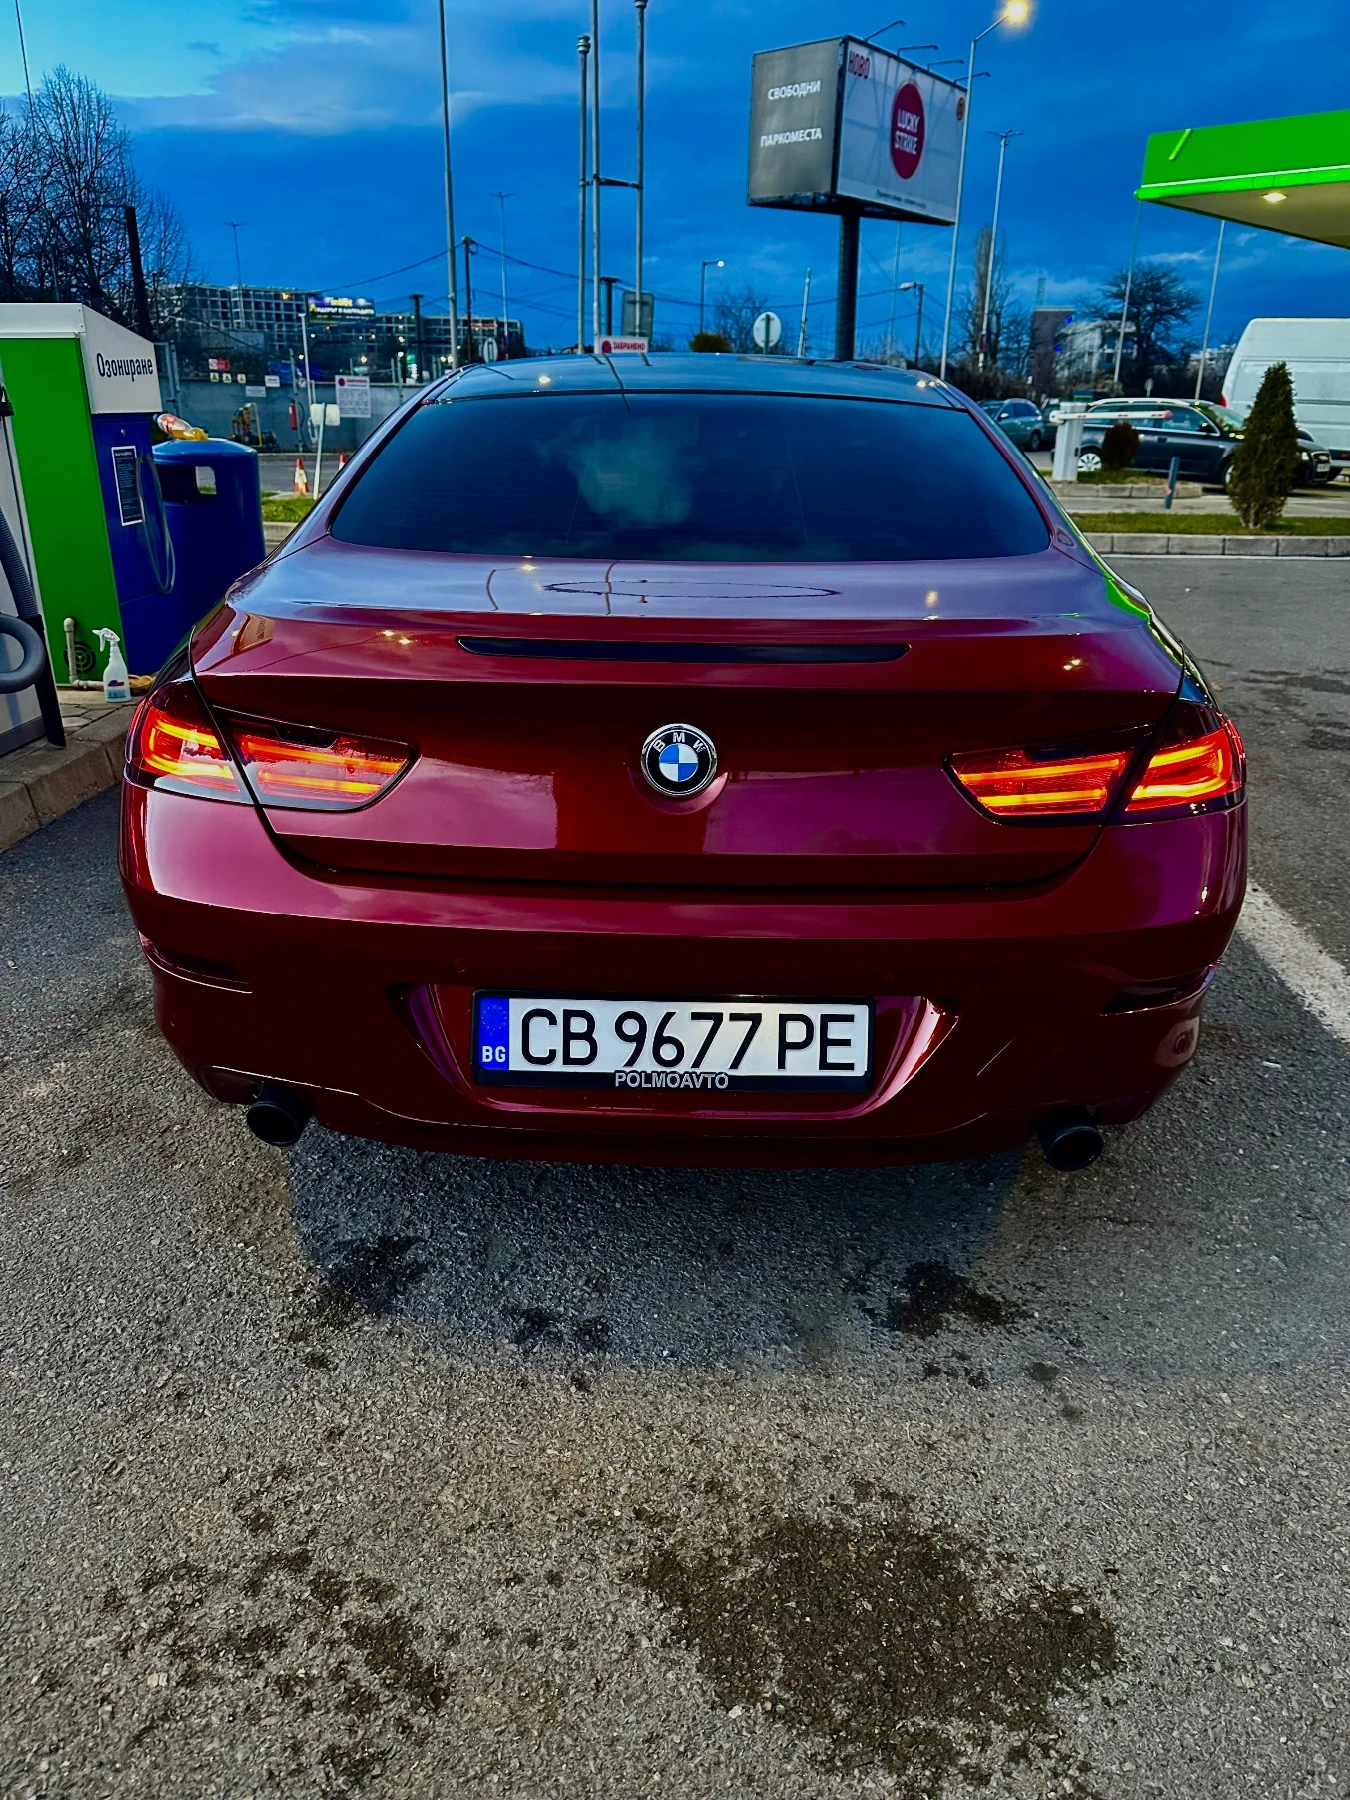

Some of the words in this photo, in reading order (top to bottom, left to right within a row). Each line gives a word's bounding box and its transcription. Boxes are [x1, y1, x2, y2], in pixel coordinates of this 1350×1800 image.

[767, 80, 821, 100] СВОБОДНИ
[897, 109, 921, 133] LUCKY
[760, 127, 823, 148] ПАРКОМЕСТА
[895, 131, 918, 154] STRIKE
[96, 352, 154, 382] Озониране
[652, 732, 707, 753] BMW
[520, 1008, 599, 1067] CB
[613, 1010, 763, 1070] 9677
[777, 1013, 856, 1071] PE
[481, 1045, 506, 1063] BG
[614, 1071, 730, 1090] POLMOAVTO
